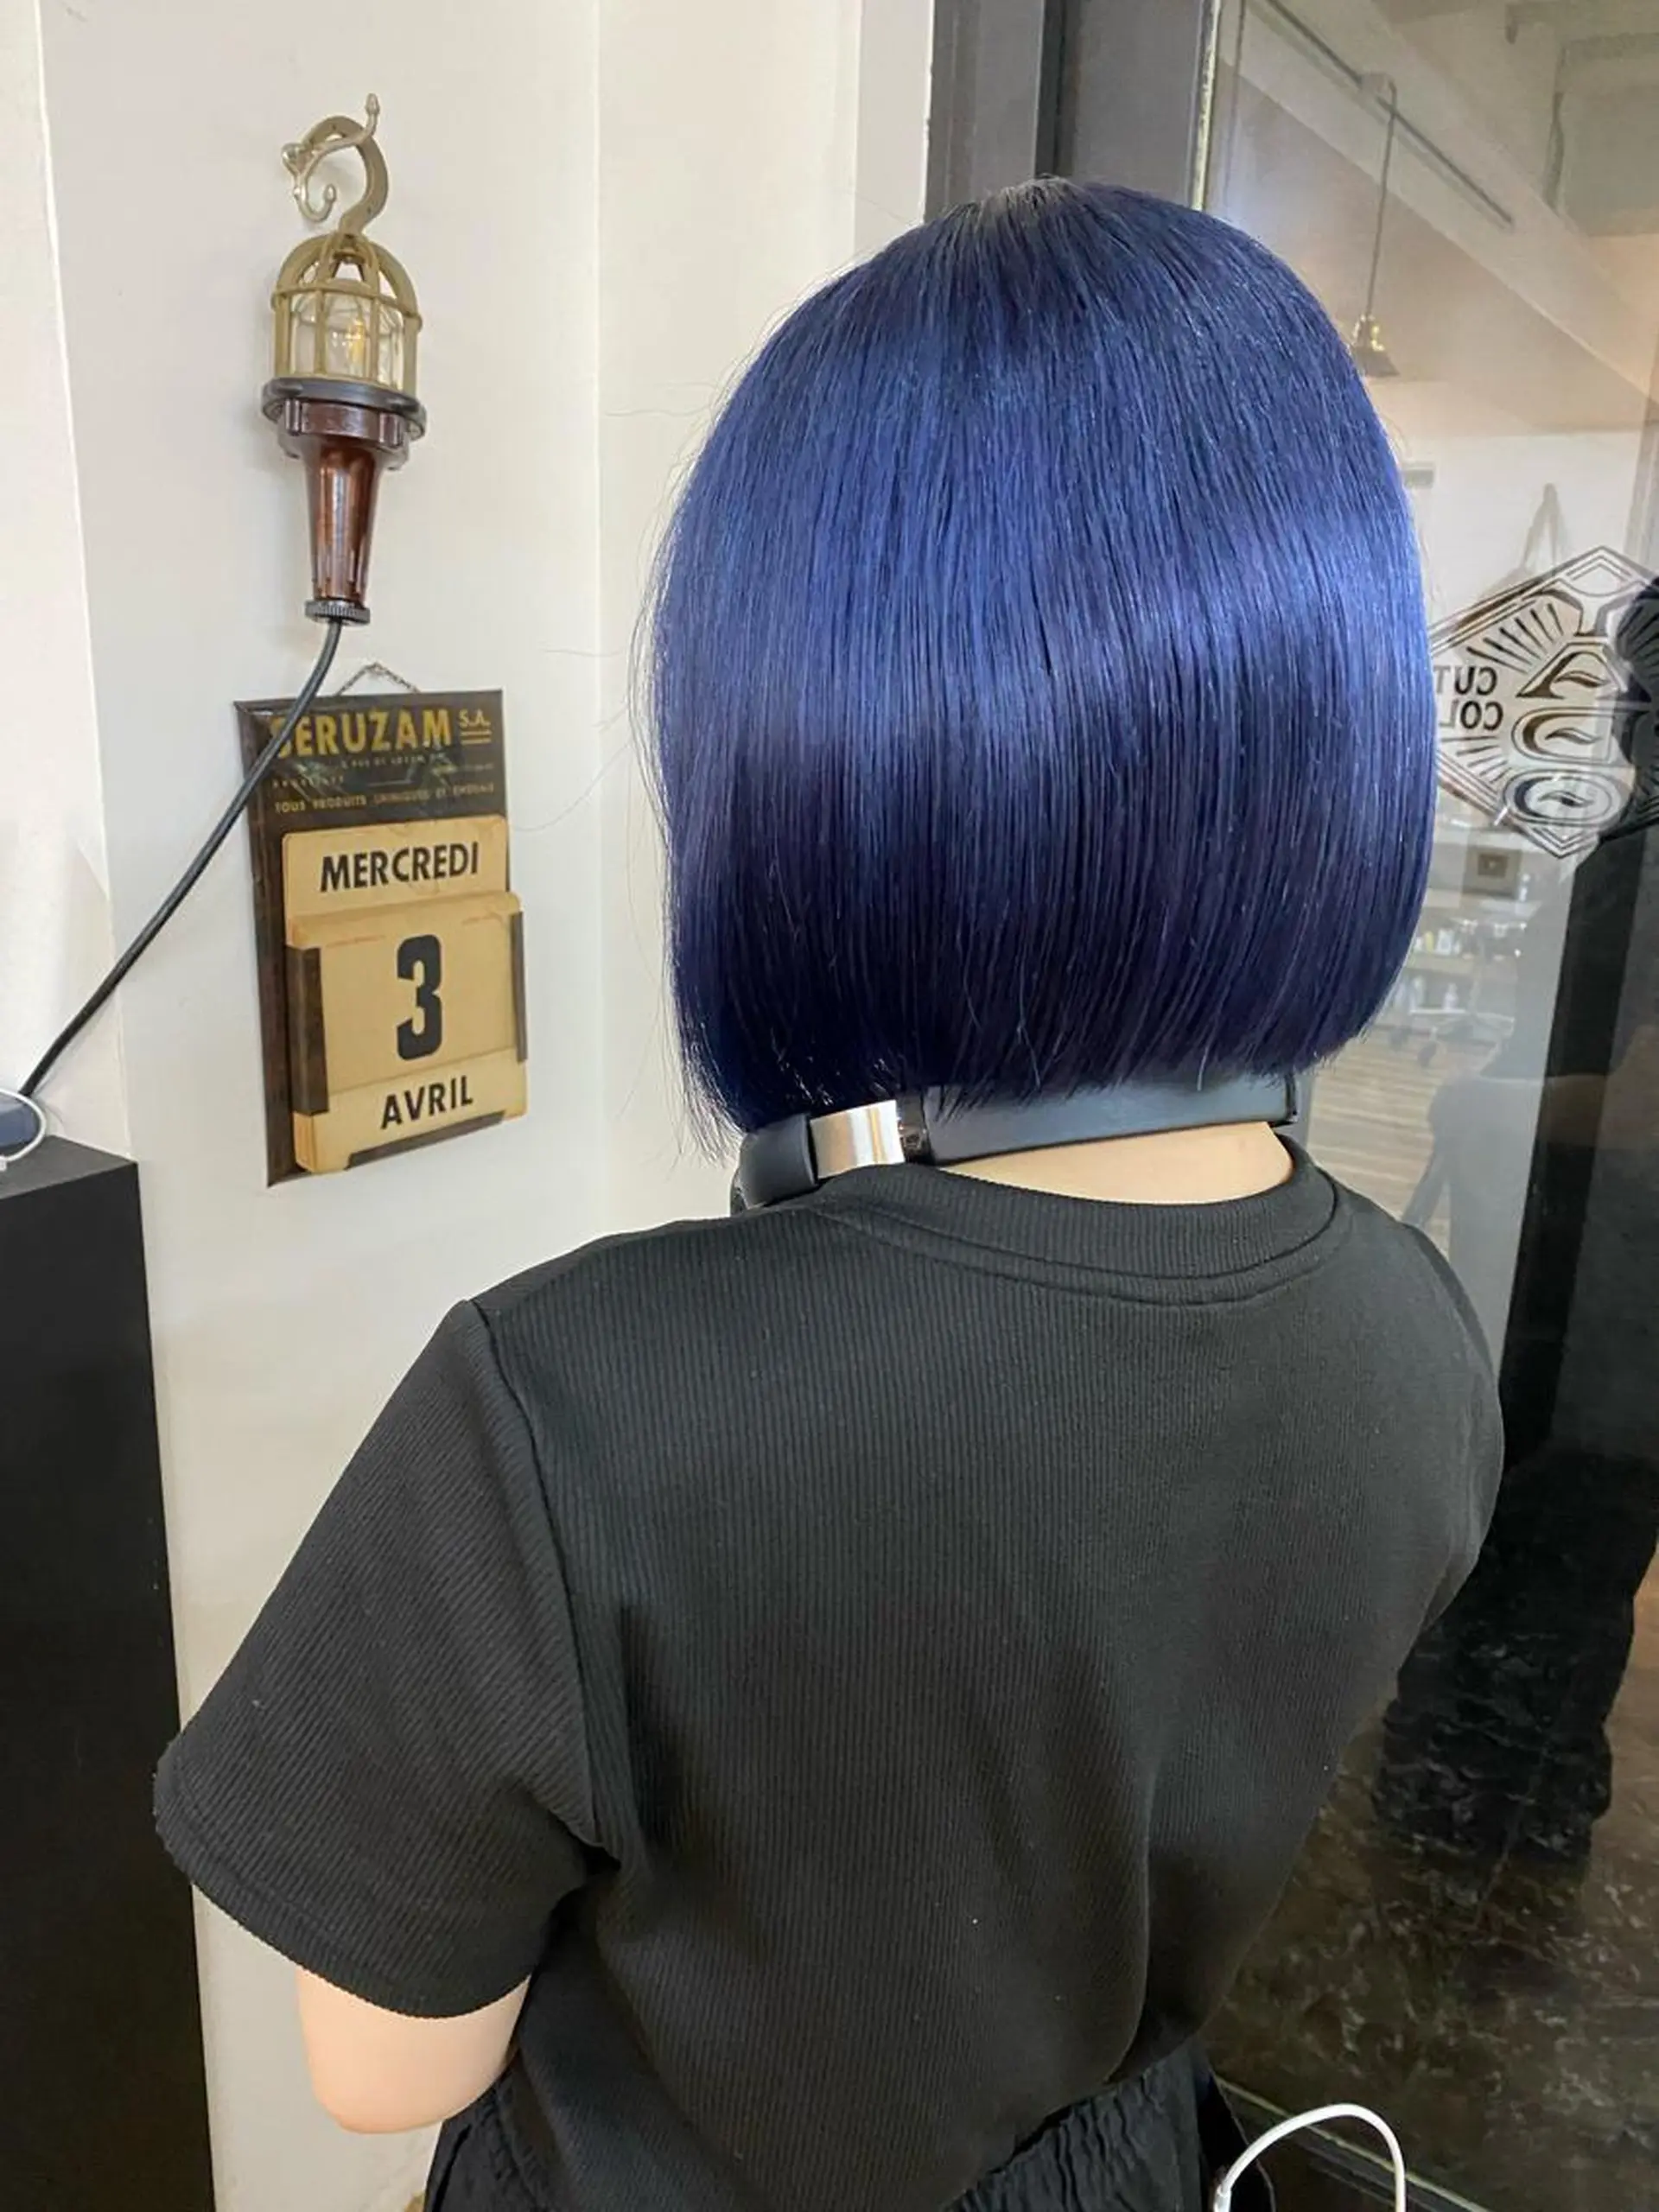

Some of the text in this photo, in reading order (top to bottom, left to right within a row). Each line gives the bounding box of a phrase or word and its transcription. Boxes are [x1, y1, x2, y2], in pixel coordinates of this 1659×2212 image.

[321, 842, 479, 893] MERCREDI
[397, 934, 442, 1061] 3
[380, 1076, 474, 1129] AVRIL
